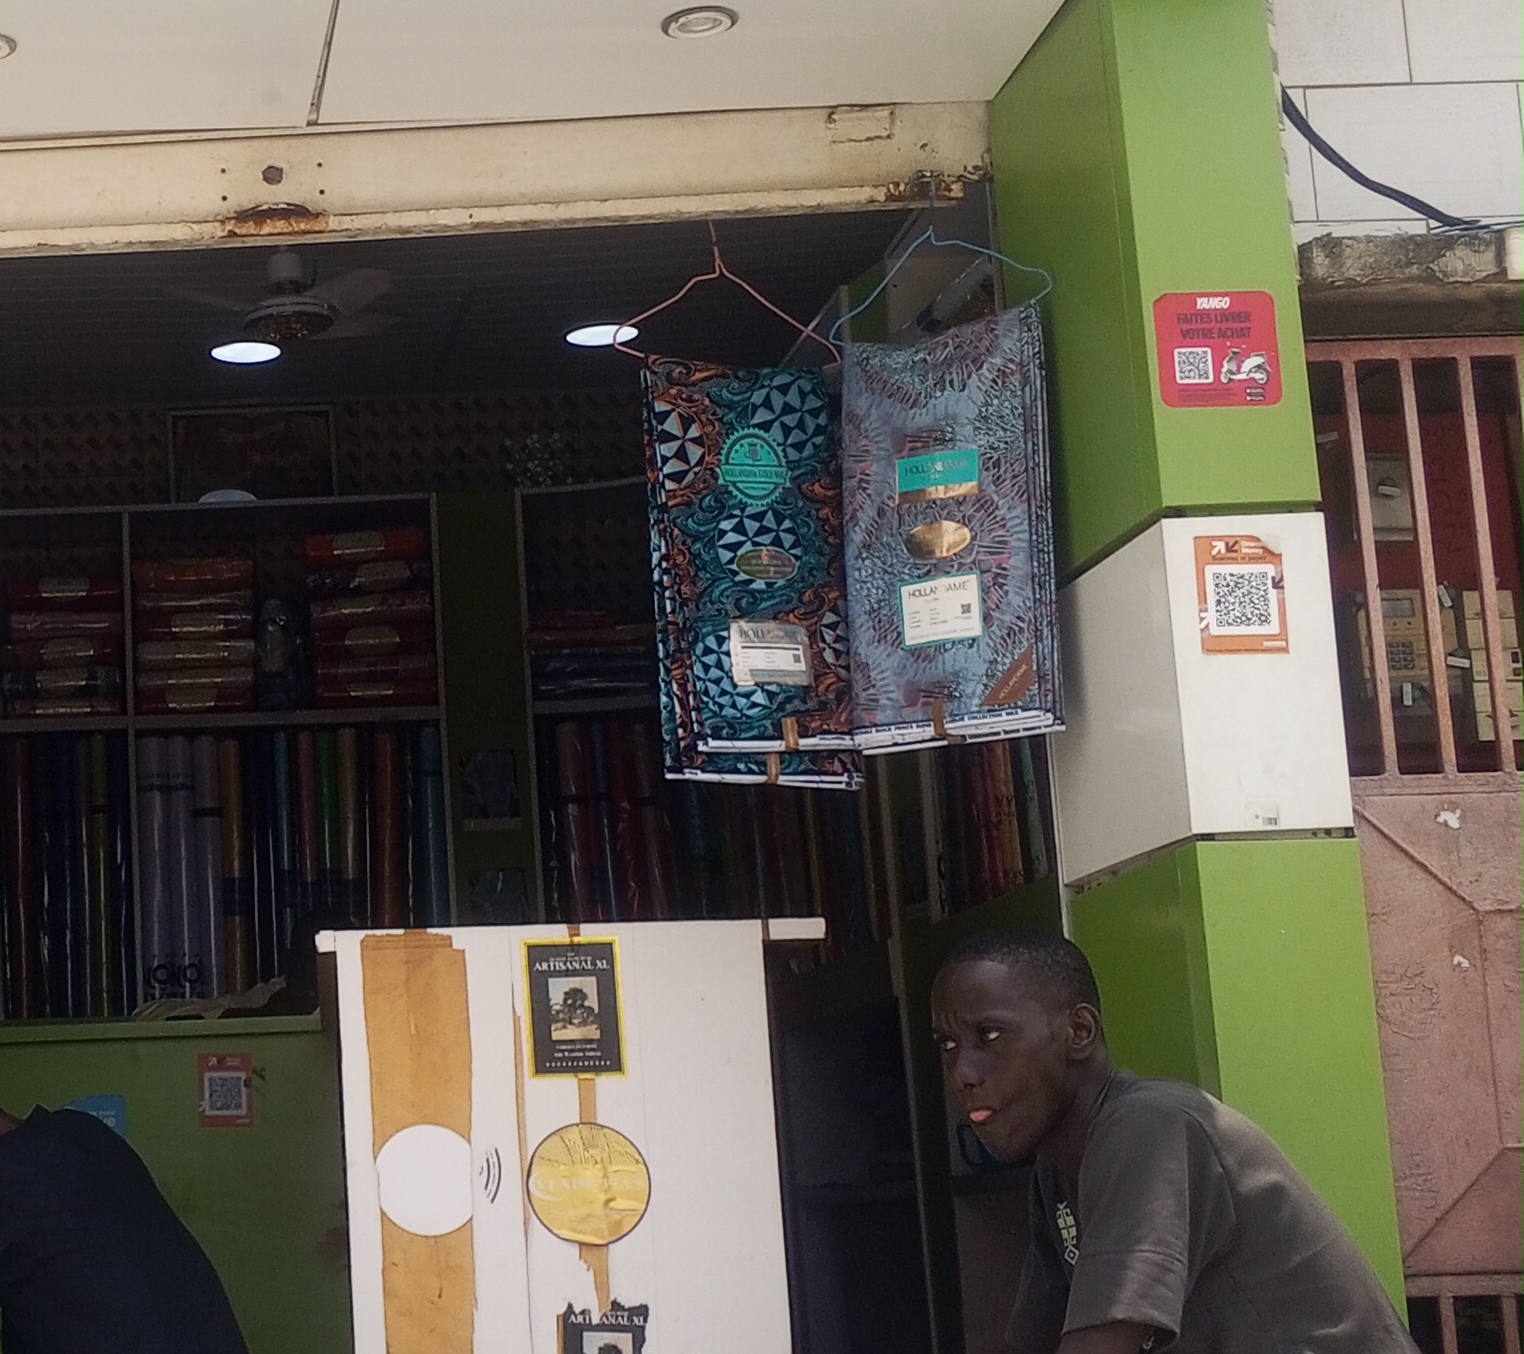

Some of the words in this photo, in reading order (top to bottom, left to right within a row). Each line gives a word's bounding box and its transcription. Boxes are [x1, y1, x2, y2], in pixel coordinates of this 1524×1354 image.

[1195, 297, 1231, 310] YANGO
[1180, 327, 1216, 340] VOTRE
[533, 959, 594, 972] ARTISANAL
[595, 959, 610, 970] XL
[568, 1313, 631, 1326] ARTANAL
[632, 1315, 647, 1326] XL
